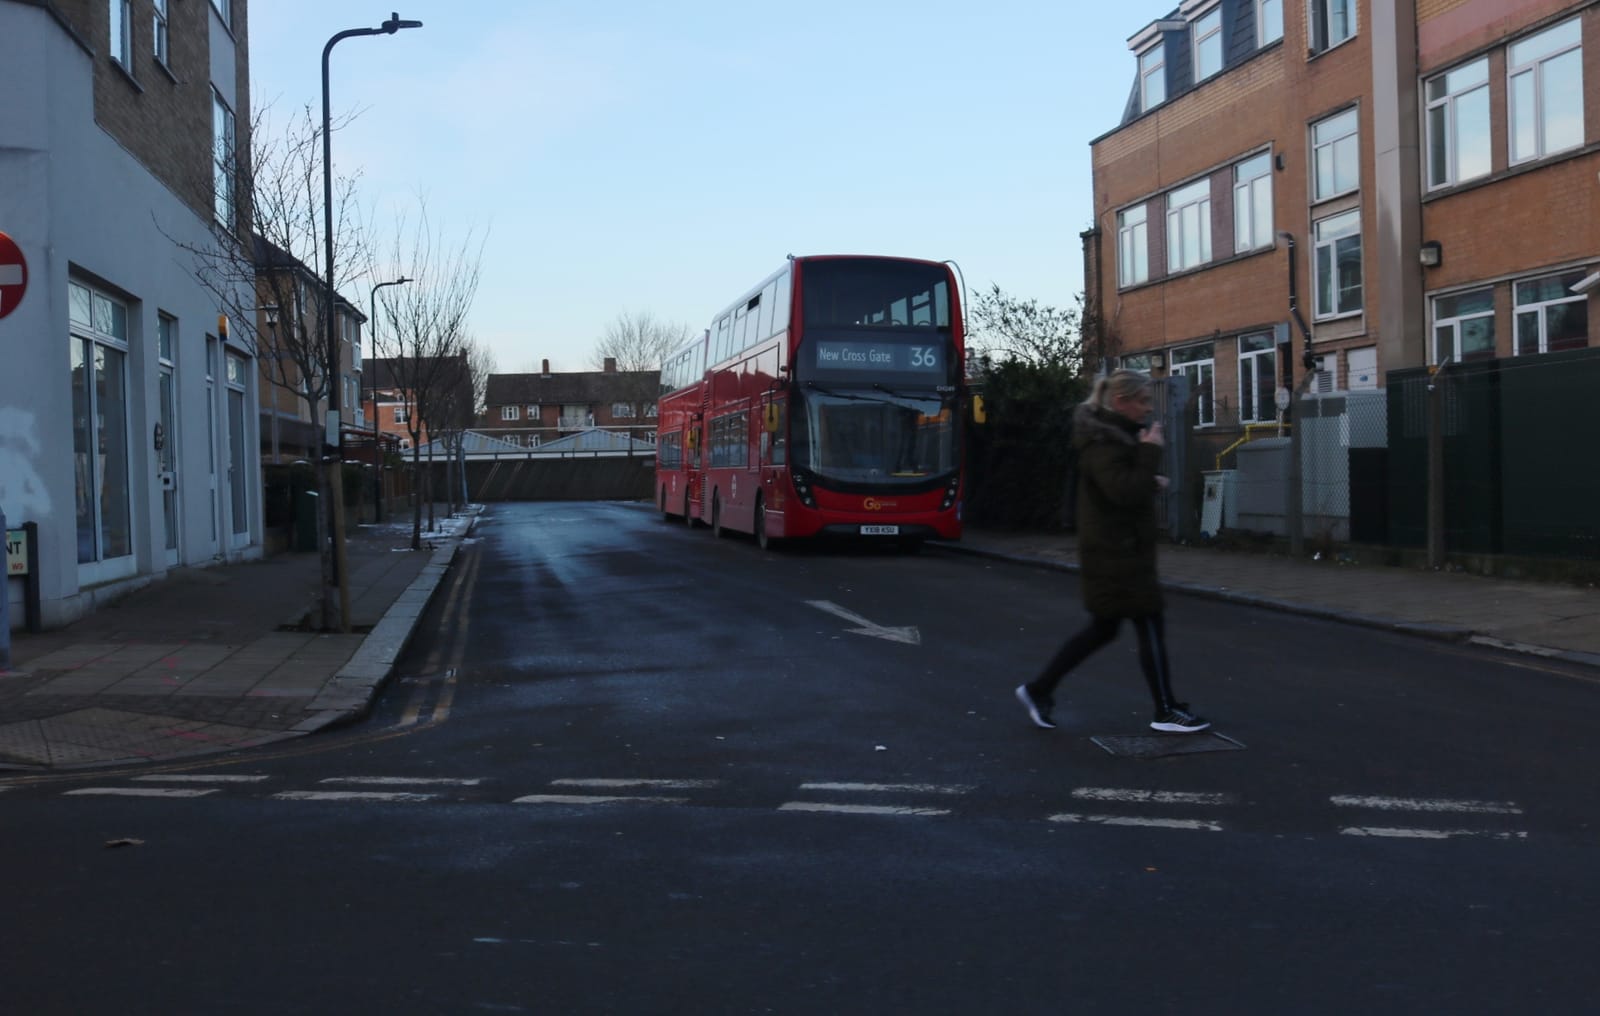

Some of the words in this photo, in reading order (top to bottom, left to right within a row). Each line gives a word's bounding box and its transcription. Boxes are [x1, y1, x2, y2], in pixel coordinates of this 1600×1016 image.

[819, 347, 839, 360] New
[842, 348, 866, 361] Cross
[869, 349, 891, 362] Gate
[911, 347, 936, 366] 36
[863, 497, 881, 510] Go
